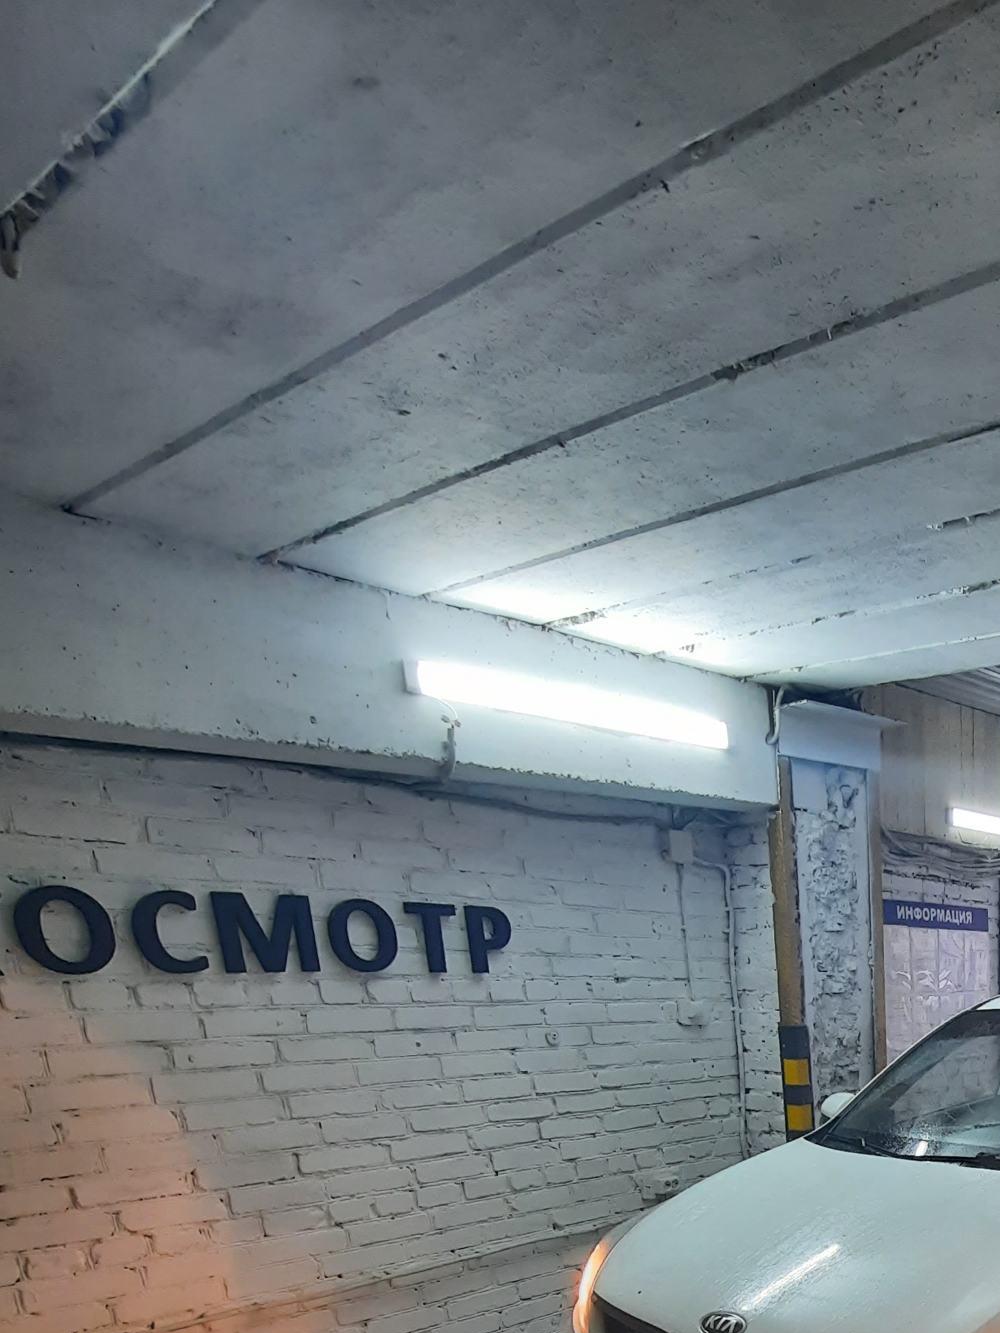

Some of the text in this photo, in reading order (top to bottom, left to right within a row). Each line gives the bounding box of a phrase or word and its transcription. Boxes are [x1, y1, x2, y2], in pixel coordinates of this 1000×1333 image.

[896, 905, 973, 926] ИНФОРМАЦИЯ
[0, 885, 512, 976] ОСМОТР
[703, 1314, 739, 1333] KIA
